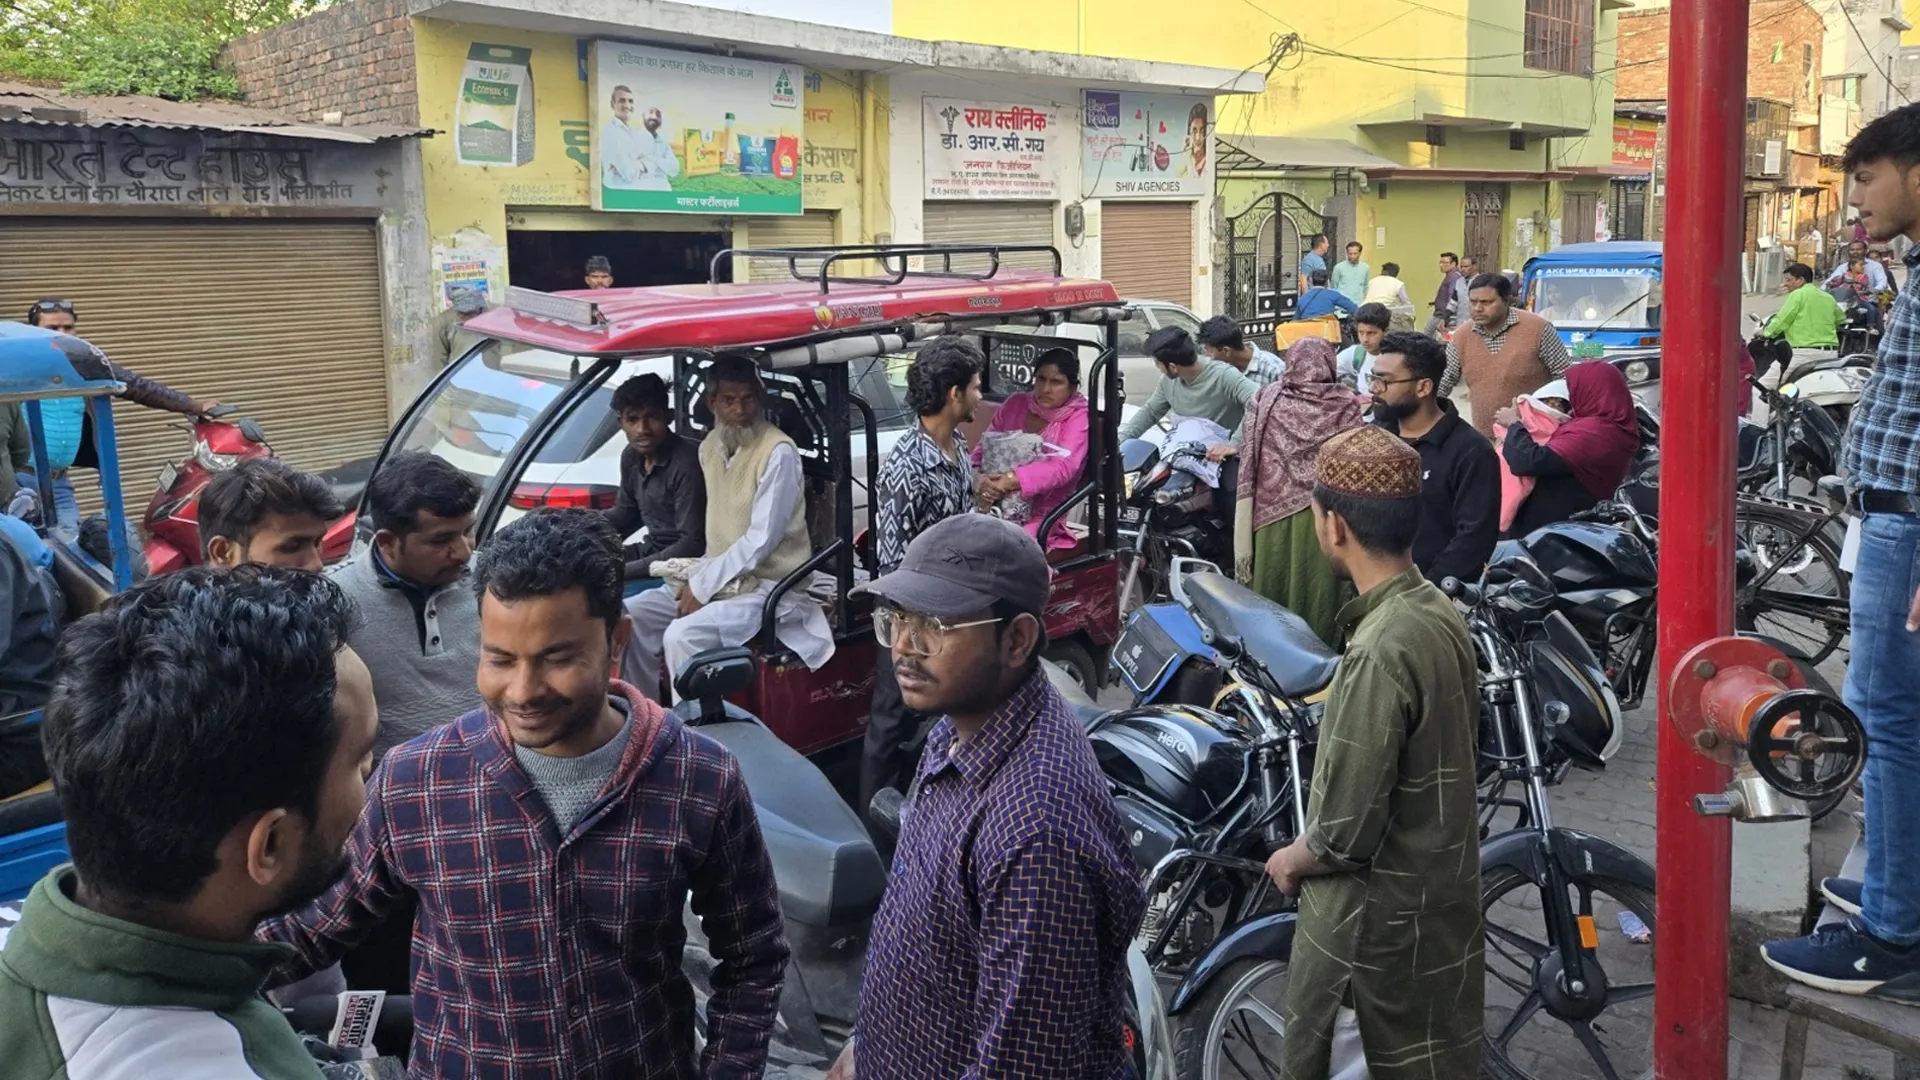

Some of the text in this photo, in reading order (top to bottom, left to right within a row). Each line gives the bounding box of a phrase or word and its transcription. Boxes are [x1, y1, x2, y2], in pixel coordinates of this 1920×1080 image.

[646, 57, 659, 68] का
[472, 82, 509, 98] Ecomax-G
[964, 107, 992, 129] राय
[995, 105, 1047, 131] क्लीनिक
[118, 130, 187, 181] टेन्ट
[198, 146, 314, 184] हाउस
[1115, 181, 1180, 193] SHIV AGENCIES
[1157, 731, 1186, 753] Hero
